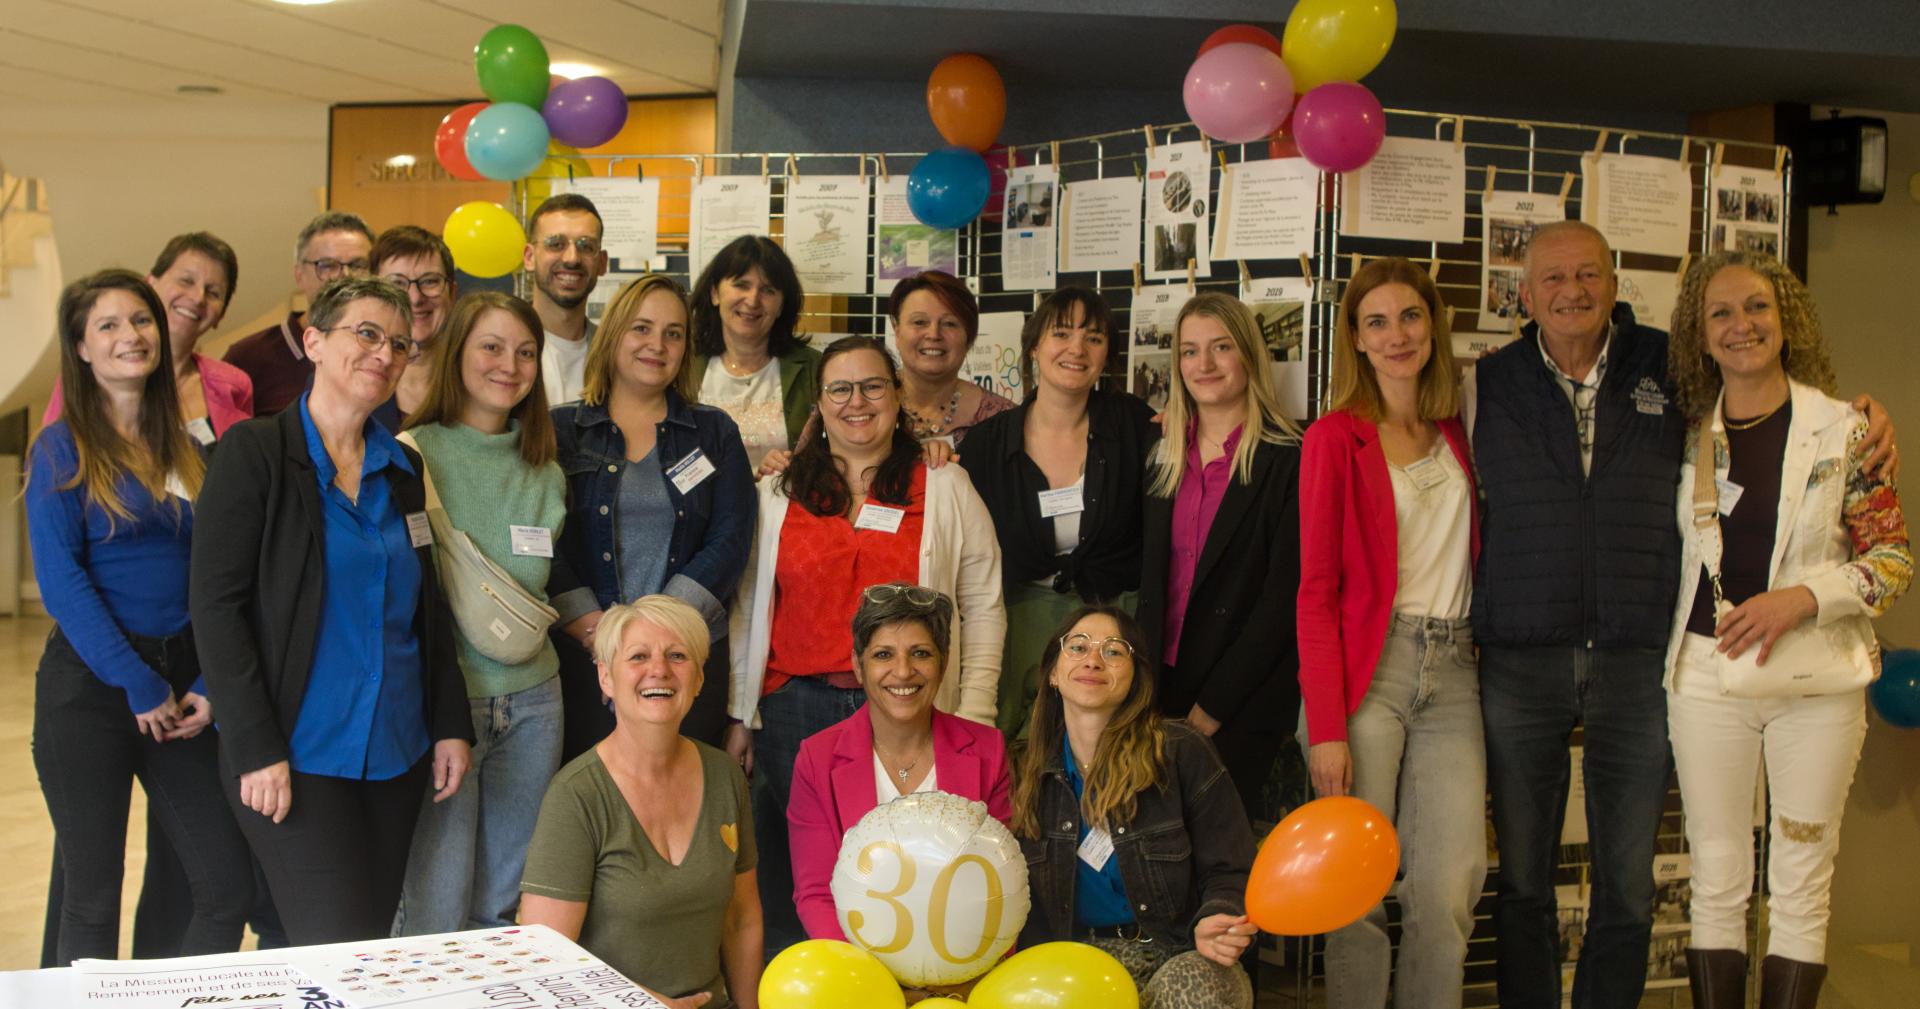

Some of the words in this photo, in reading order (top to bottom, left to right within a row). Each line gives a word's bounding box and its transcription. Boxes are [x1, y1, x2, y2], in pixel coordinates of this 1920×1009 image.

[1265, 287, 1284, 297] 2019
[847, 840, 1004, 966] 30
[100, 979, 119, 988] La
[125, 974, 194, 987] Mission
[199, 971, 254, 982] Locale
[258, 969, 280, 977] du
[88, 986, 203, 999] Remiremont
[209, 984, 225, 992] et
[231, 981, 252, 990] de
